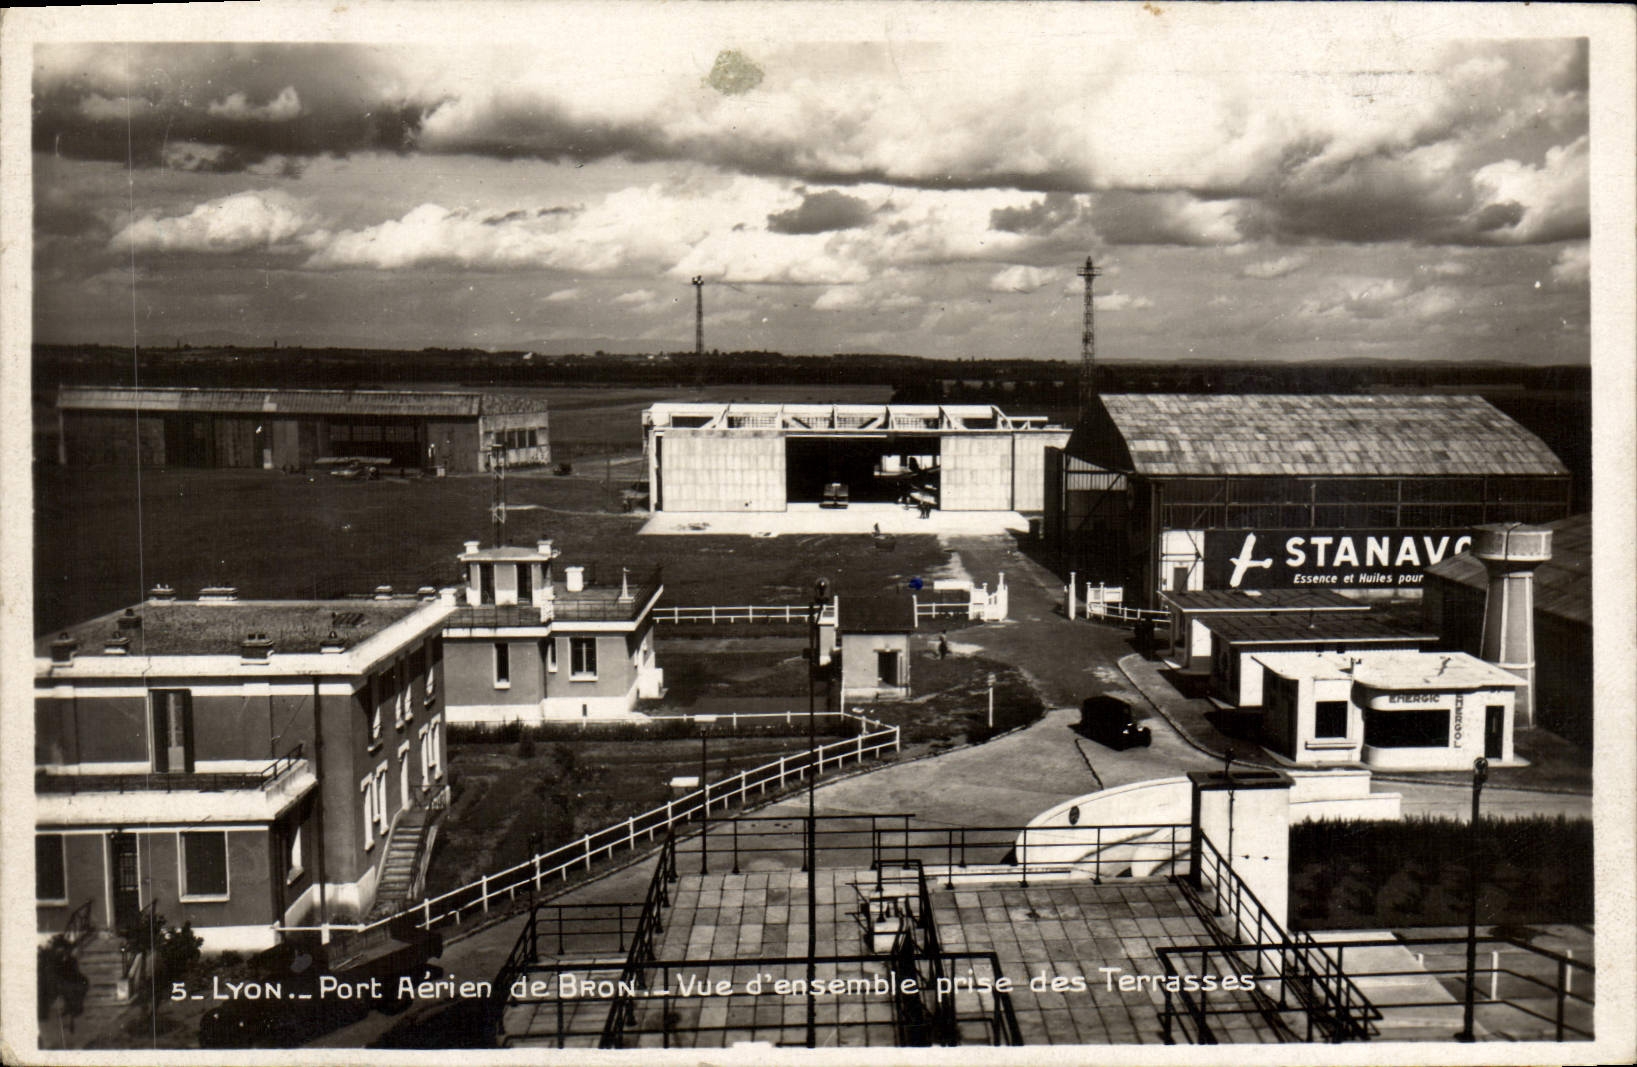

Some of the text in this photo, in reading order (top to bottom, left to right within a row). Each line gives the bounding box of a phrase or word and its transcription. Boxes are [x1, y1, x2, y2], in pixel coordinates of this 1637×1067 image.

[1293, 573, 1424, 586] Essence et Huiles pour
